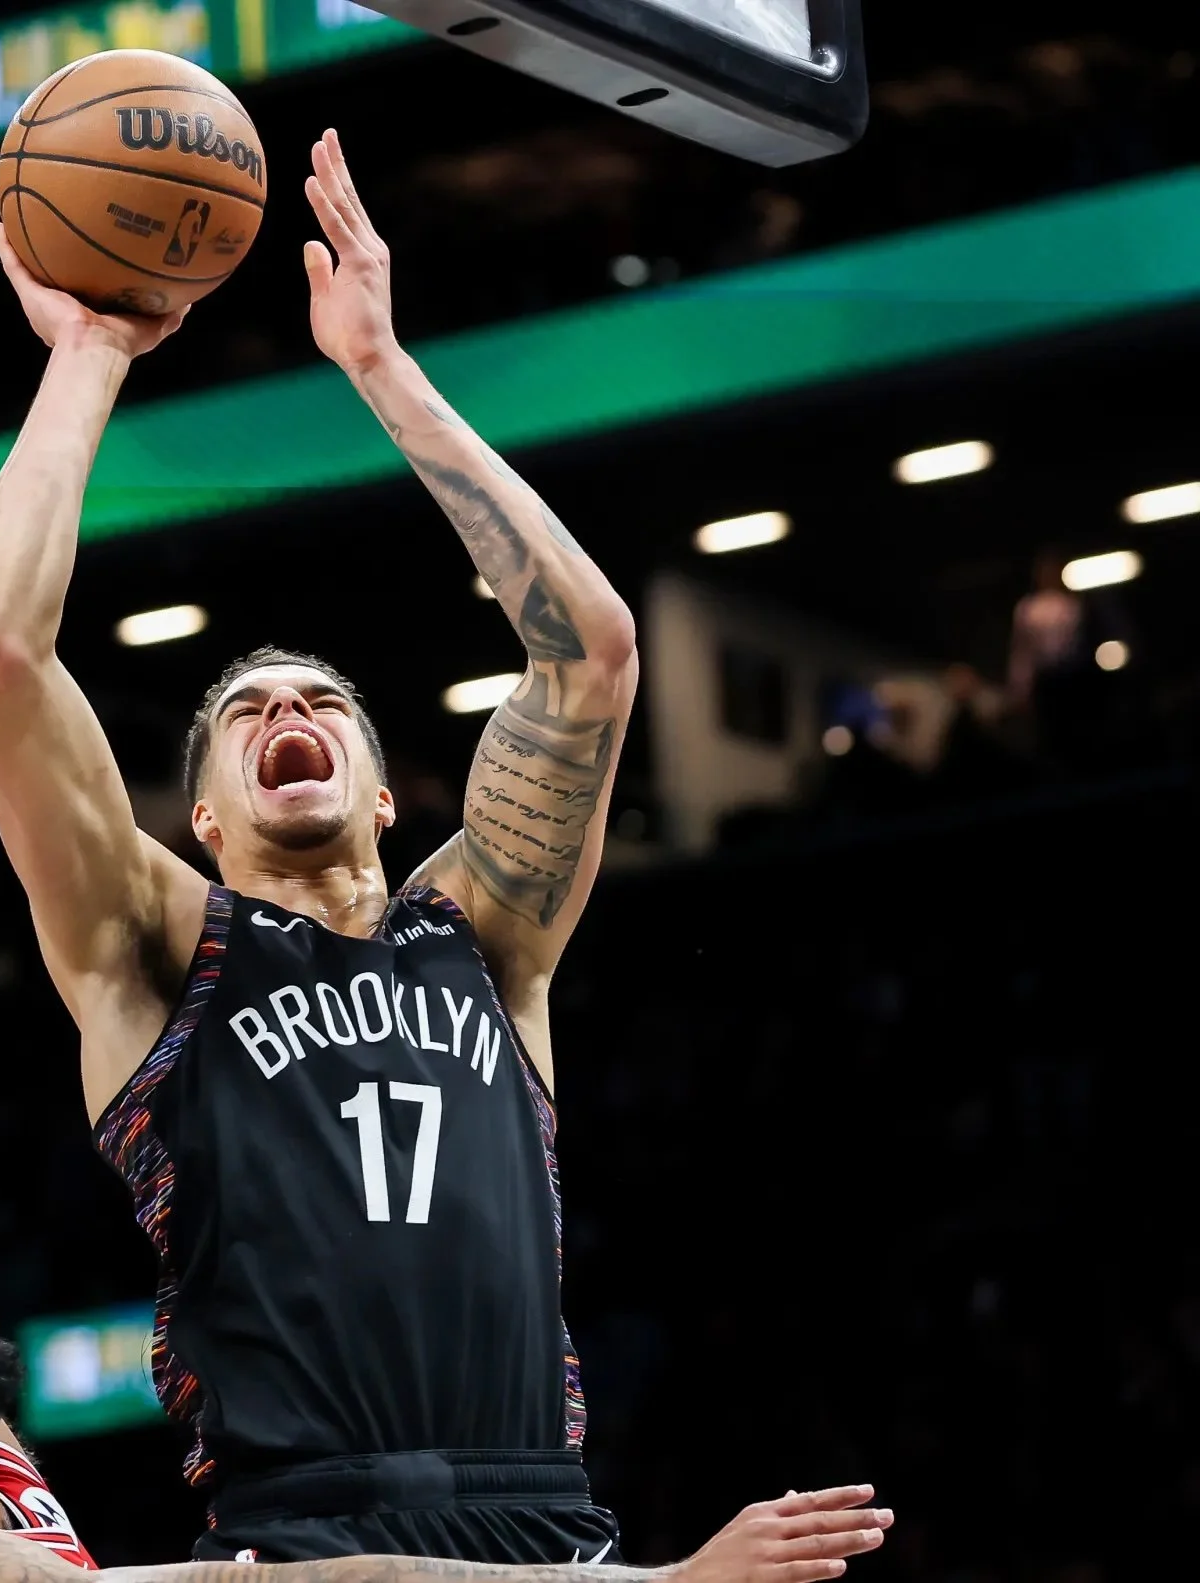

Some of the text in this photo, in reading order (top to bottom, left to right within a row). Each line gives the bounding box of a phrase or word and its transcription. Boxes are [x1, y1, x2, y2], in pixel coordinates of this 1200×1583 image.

[114, 106, 264, 188] Wilson
[404, 925, 424, 941] In
[228, 971, 501, 1086] BROOKLYN
[340, 1081, 442, 1224] 17
